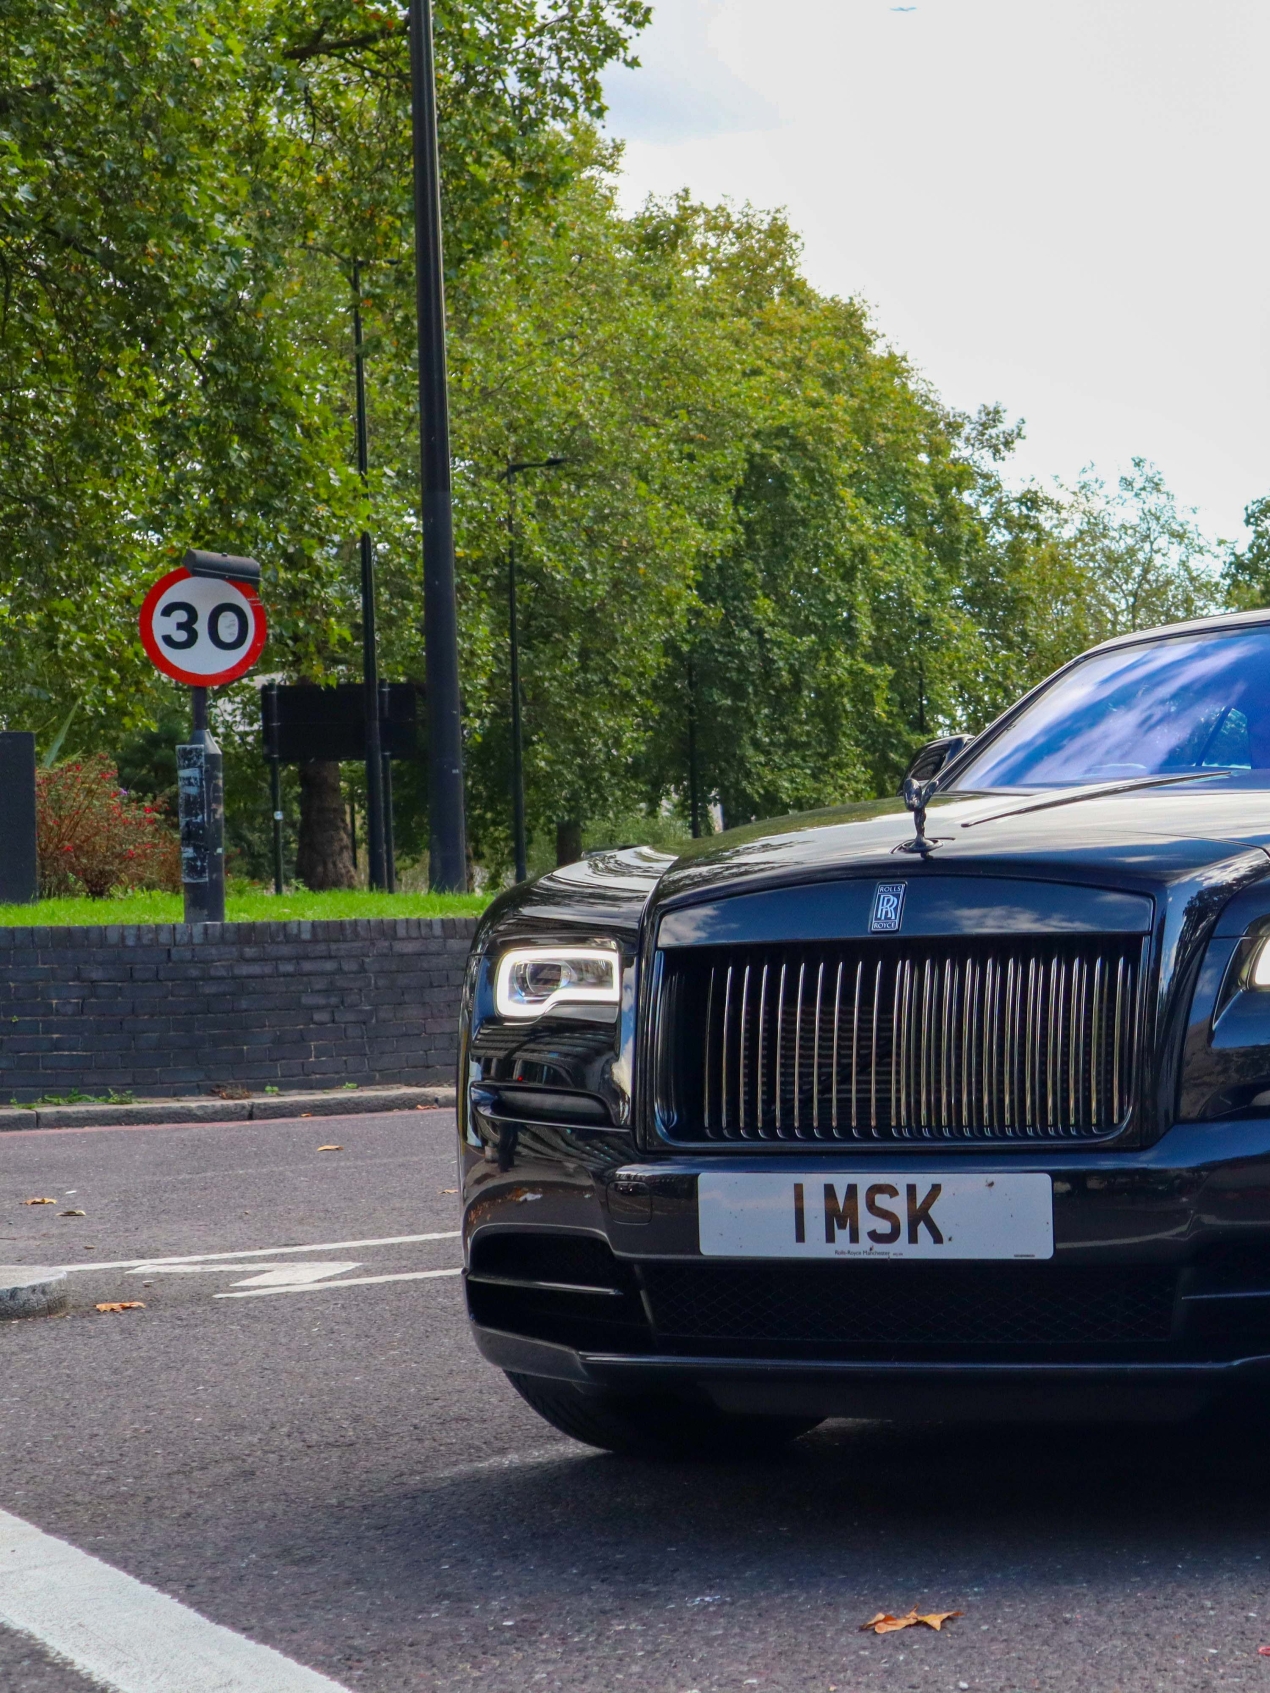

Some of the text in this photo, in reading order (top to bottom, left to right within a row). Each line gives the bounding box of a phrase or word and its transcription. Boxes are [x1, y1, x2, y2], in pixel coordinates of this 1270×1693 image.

[160, 601, 249, 651] 30
[873, 921, 896, 929] ROYCE
[823, 1183, 944, 1244] MSK
